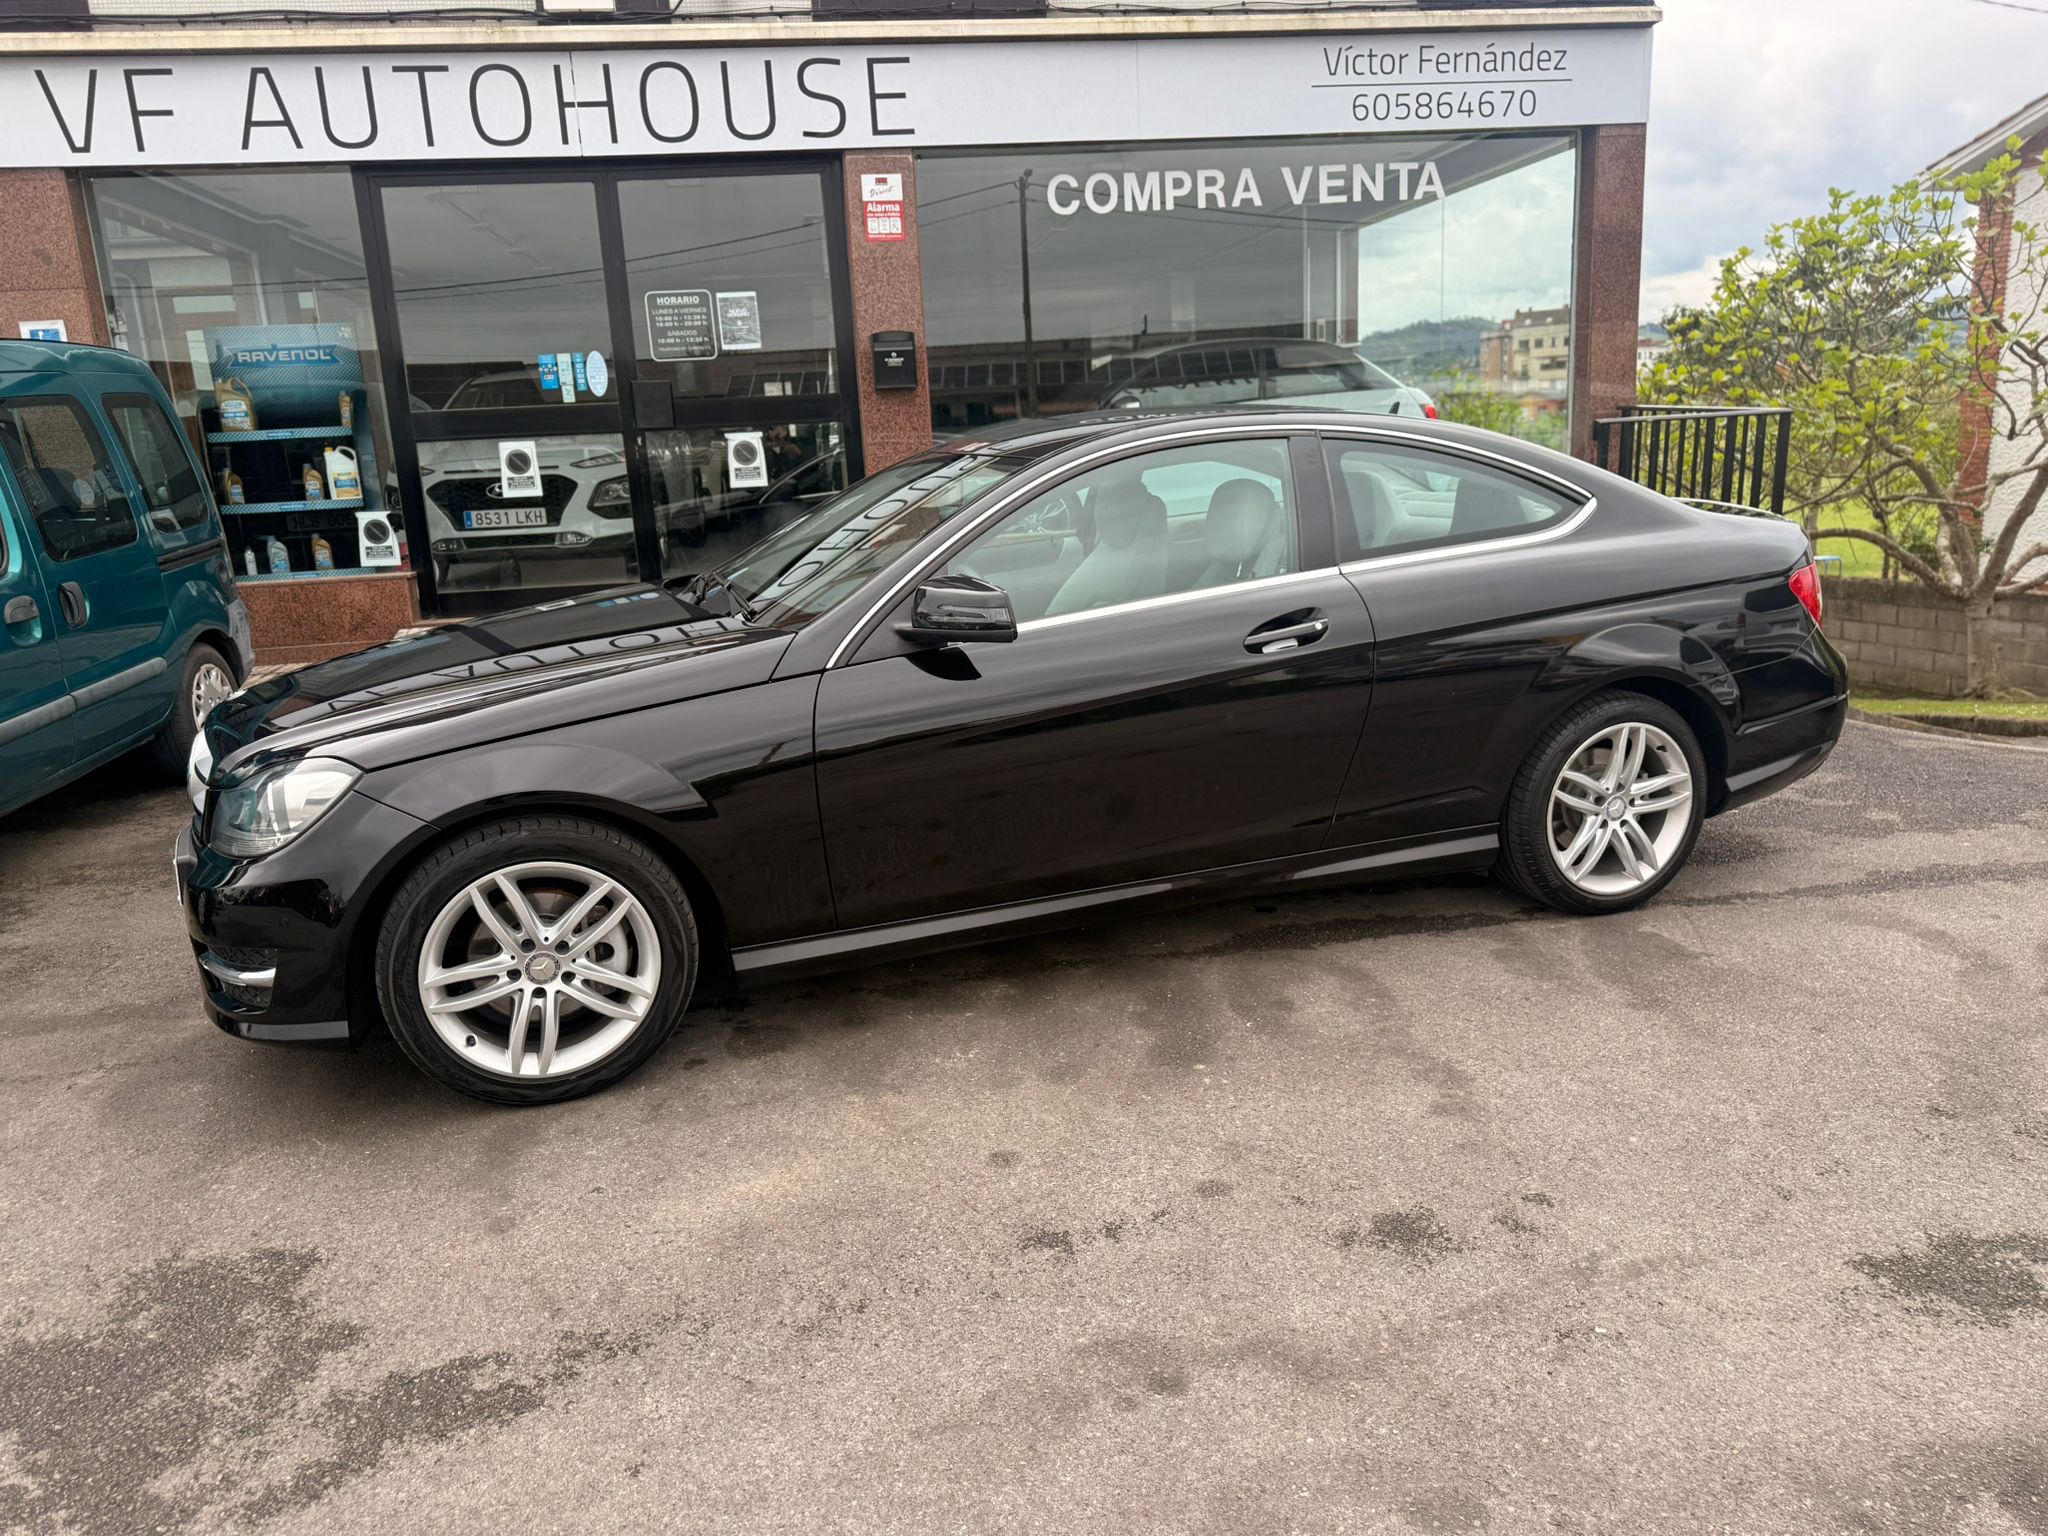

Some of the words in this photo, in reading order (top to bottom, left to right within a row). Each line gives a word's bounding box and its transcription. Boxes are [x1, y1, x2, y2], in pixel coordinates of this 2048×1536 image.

[1323, 44, 1409, 76] Víctor
[1418, 42, 1567, 74] Fernández
[34, 67, 174, 153] VF
[242, 56, 916, 151] AUTOHOUSE
[1352, 90, 1537, 121] 605864670
[1046, 168, 1263, 216] COMPRA
[1281, 161, 1445, 205] VENTA
[867, 202, 901, 212] Alarma
[656, 295, 700, 305] HORARIO
[237, 348, 331, 363] RAVENOL
[475, 511, 510, 526] 8531
[515, 510, 543, 524] LKH
